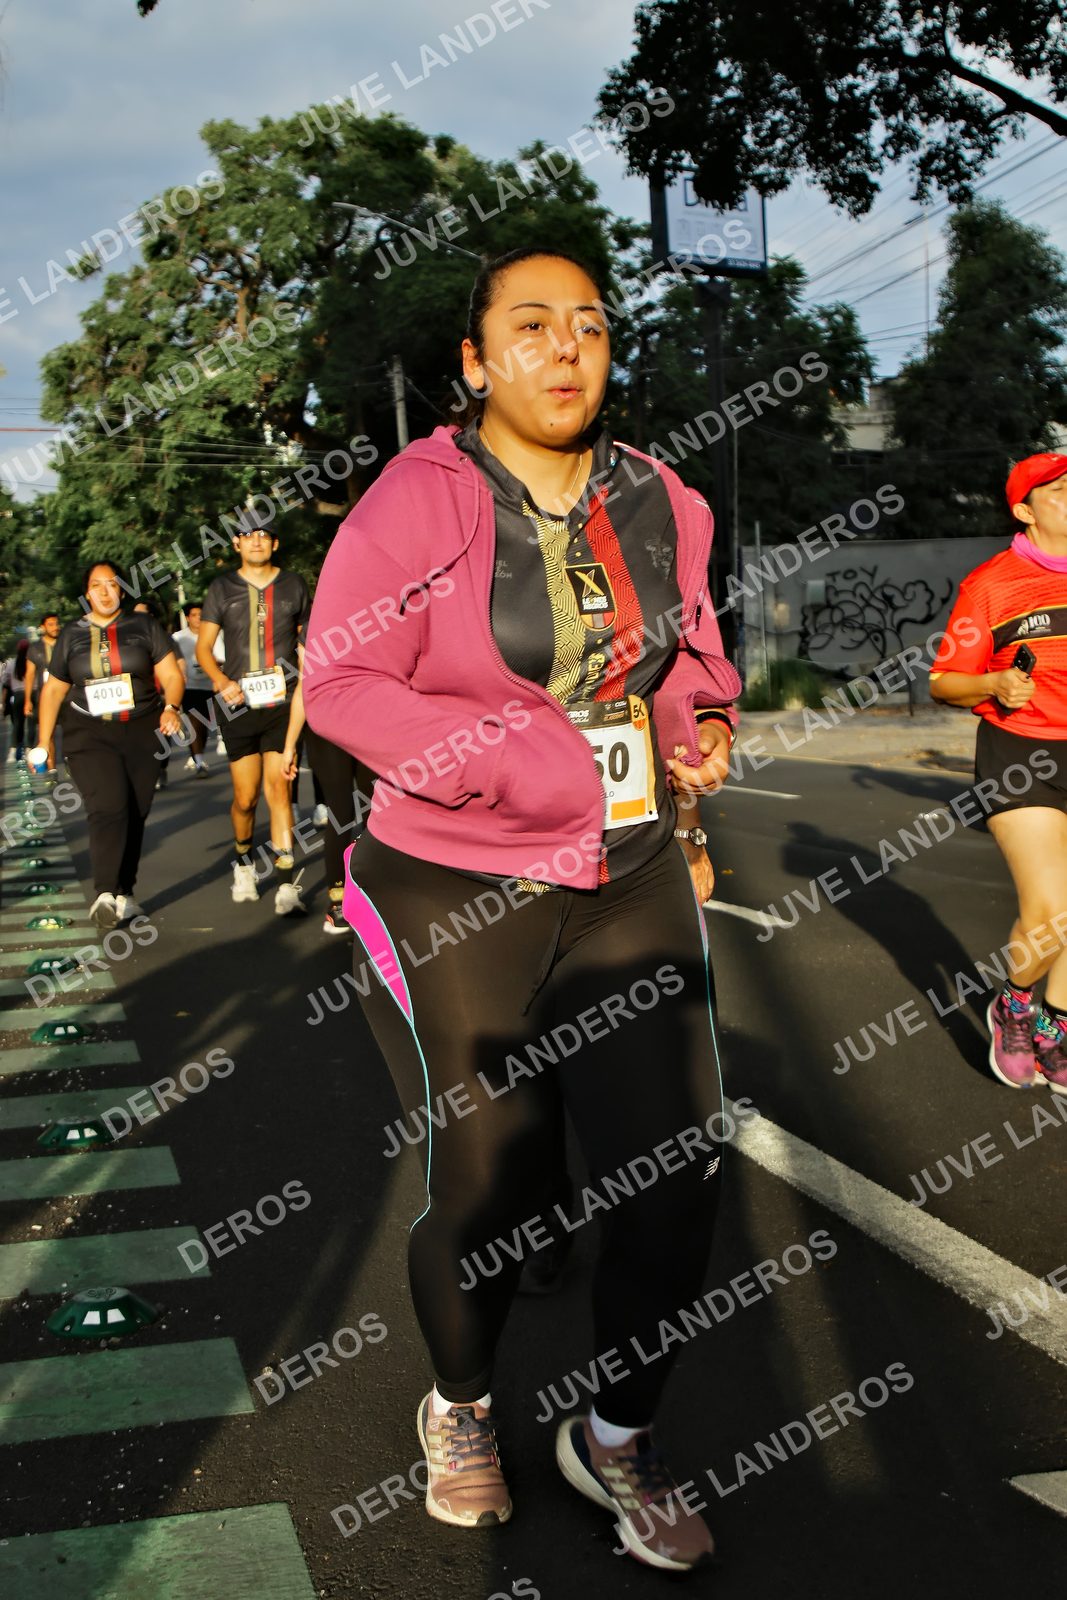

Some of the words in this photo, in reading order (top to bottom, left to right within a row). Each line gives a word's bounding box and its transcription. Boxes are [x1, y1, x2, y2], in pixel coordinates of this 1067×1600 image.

[825, 564, 879, 585] TOY
[93, 686, 123, 701] 4010
[248, 679, 276, 693] 4013
[633, 702, 645, 718] 5K
